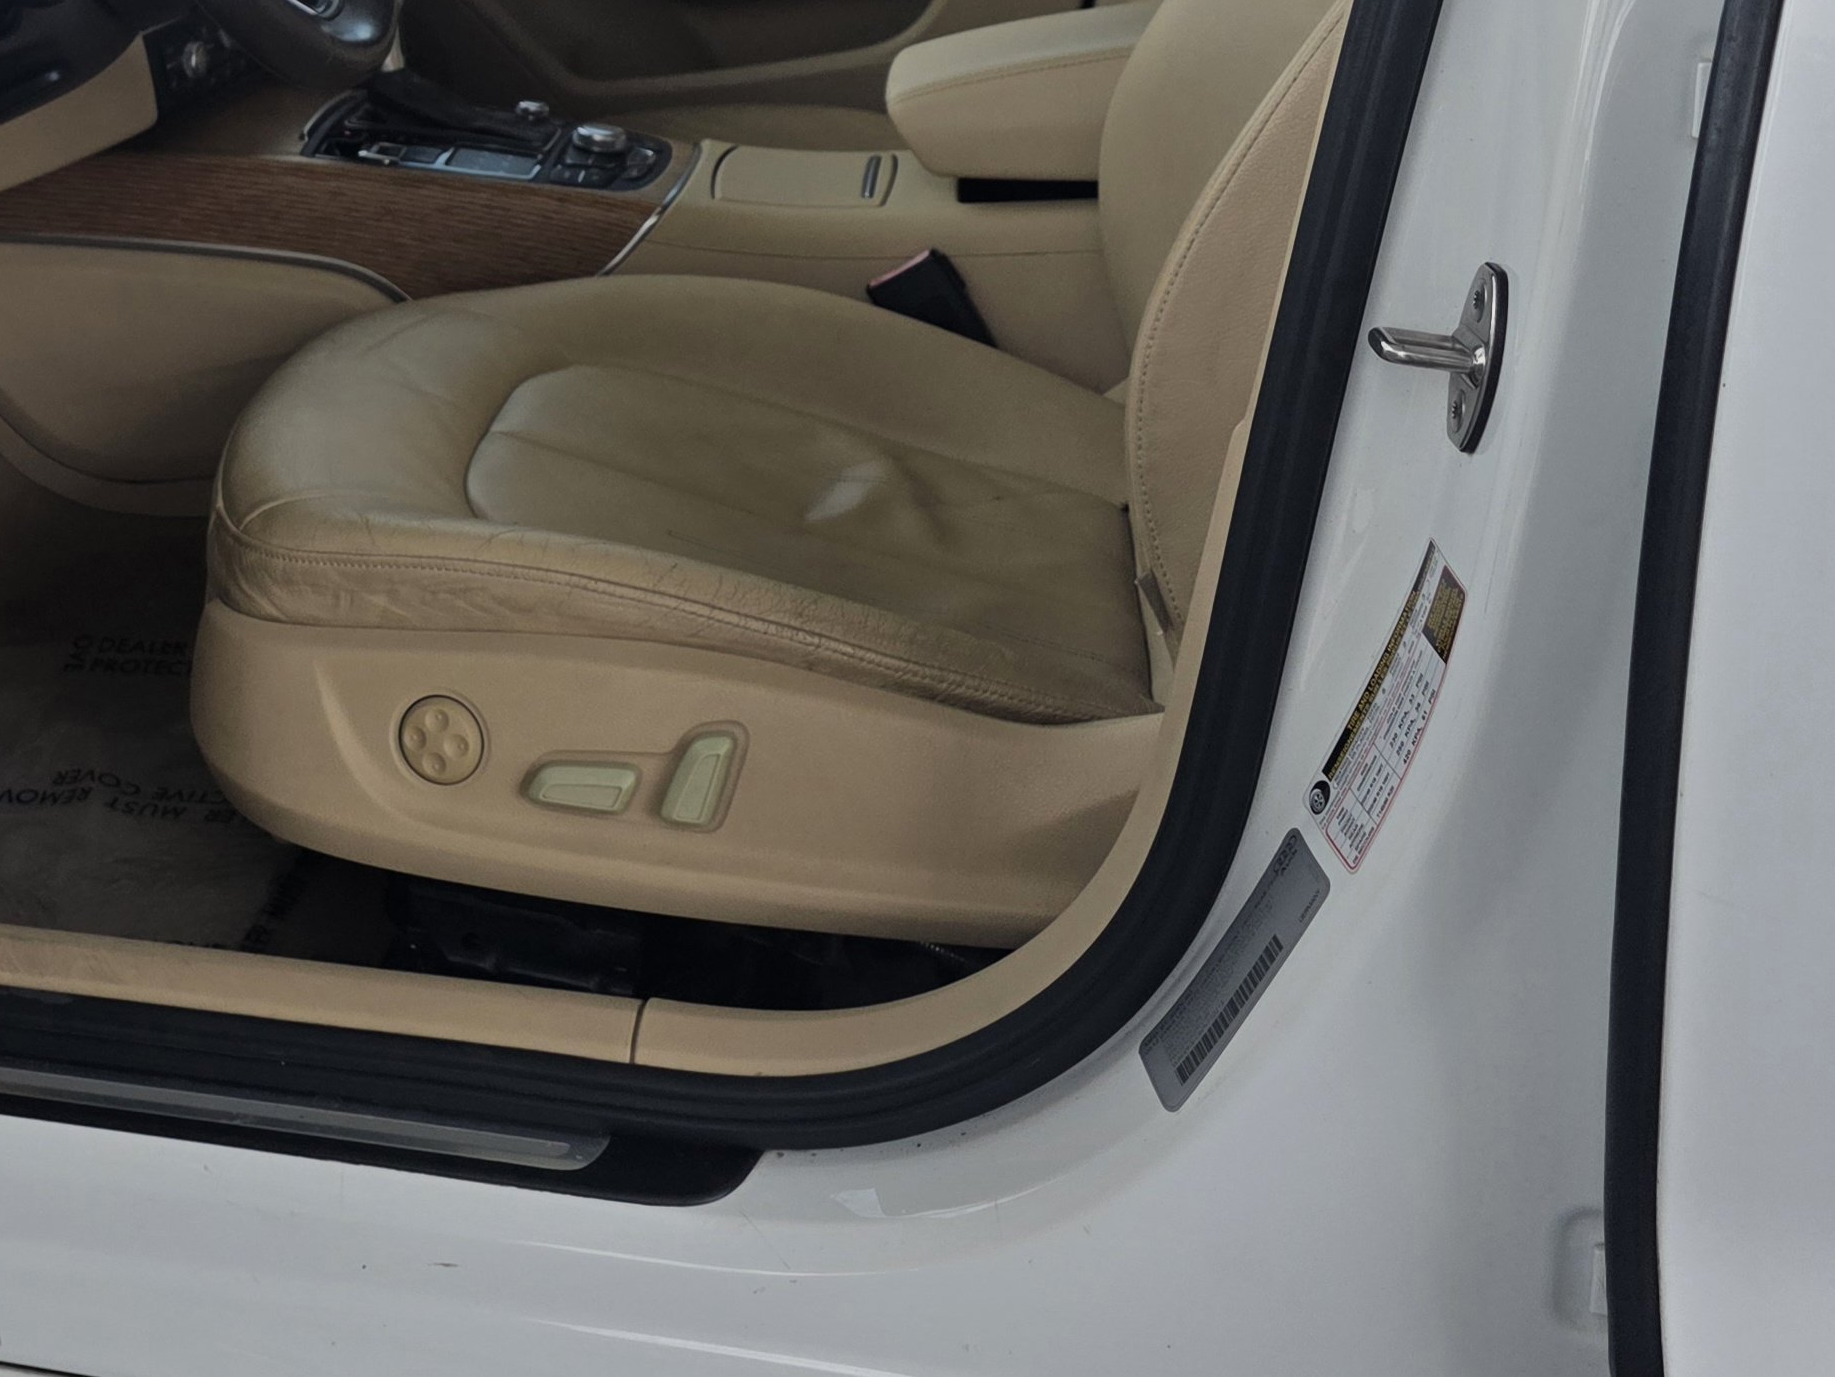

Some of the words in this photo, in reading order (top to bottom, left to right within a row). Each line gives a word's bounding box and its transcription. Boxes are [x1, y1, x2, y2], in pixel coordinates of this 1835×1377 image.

[1345, 710, 1360, 731] TIRE
[1356, 689, 1371, 711] AND
[1366, 650, 1390, 691] LOADING
[1386, 589, 1417, 652] INFORMATION
[51, 767, 142, 798] COVER
[103, 796, 188, 821] MUST
